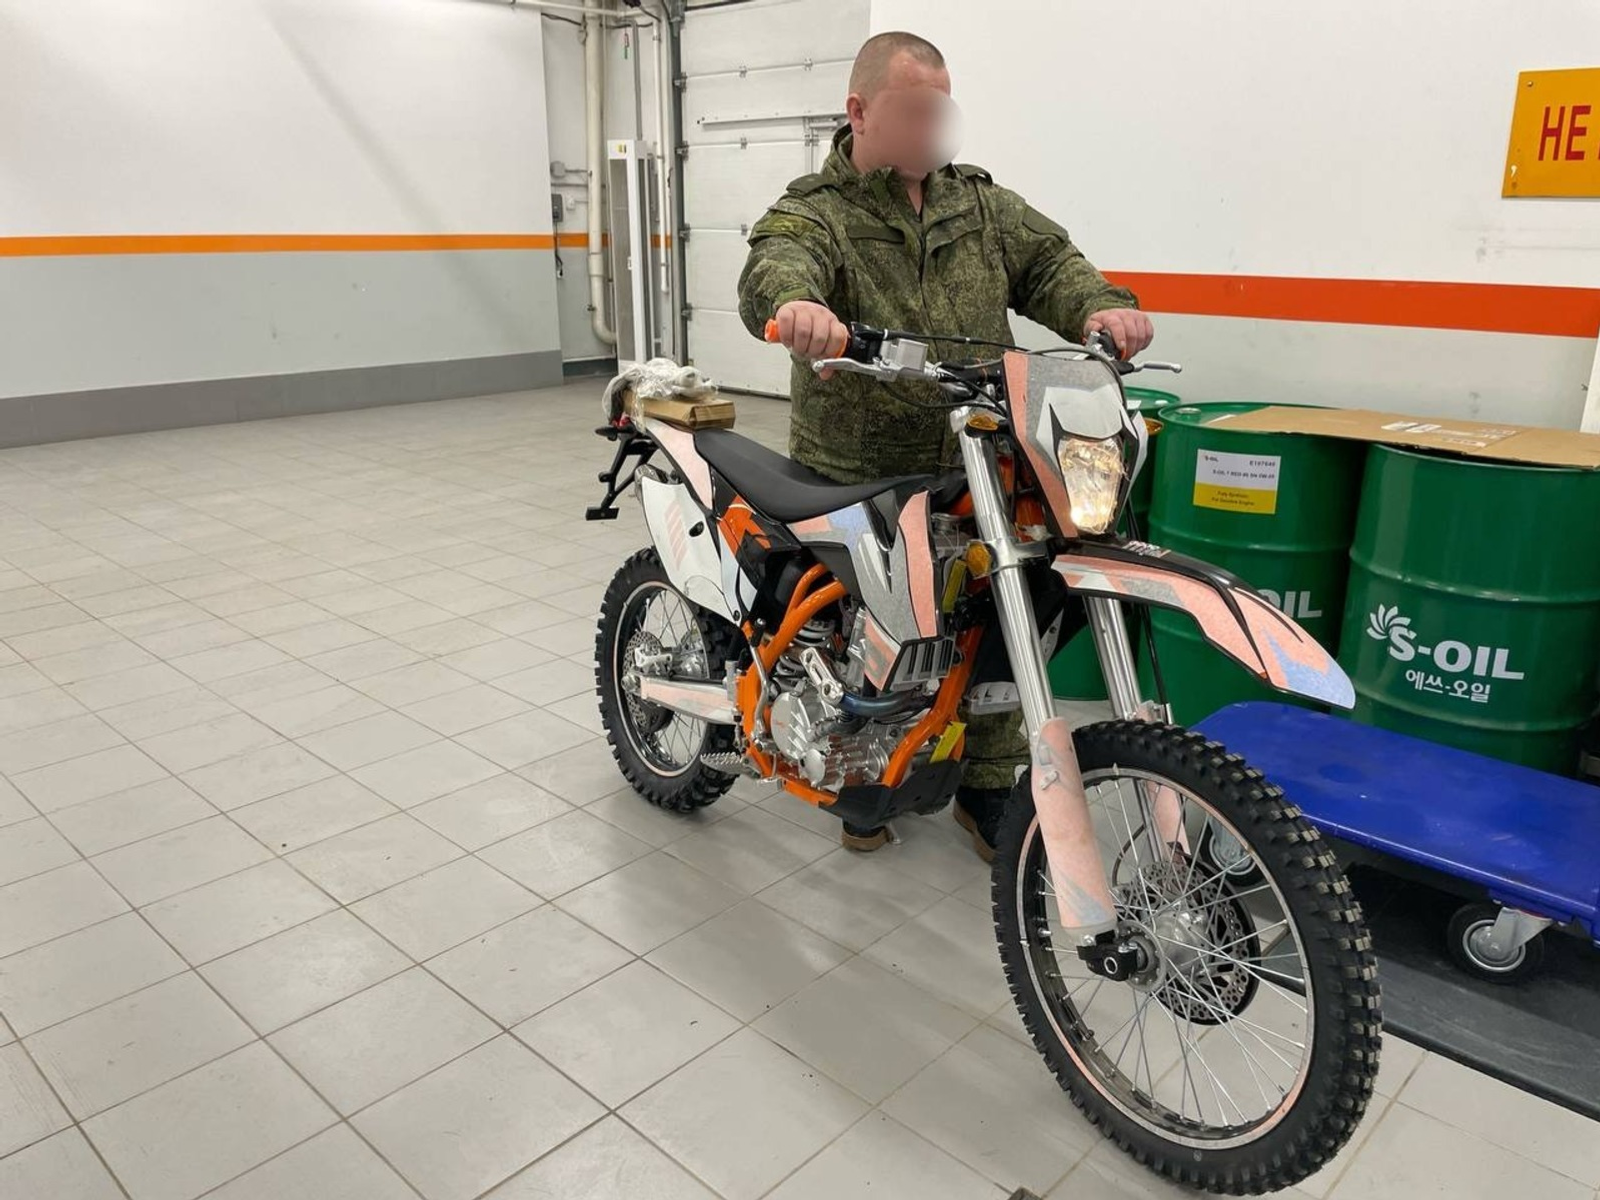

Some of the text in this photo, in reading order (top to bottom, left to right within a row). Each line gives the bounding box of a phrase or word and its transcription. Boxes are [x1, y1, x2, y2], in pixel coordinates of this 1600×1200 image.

[1538, 105, 1591, 161] НЕ
[1389, 626, 1525, 680] S-OIL
[1405, 669, 1491, 703] 에쓰-오일
